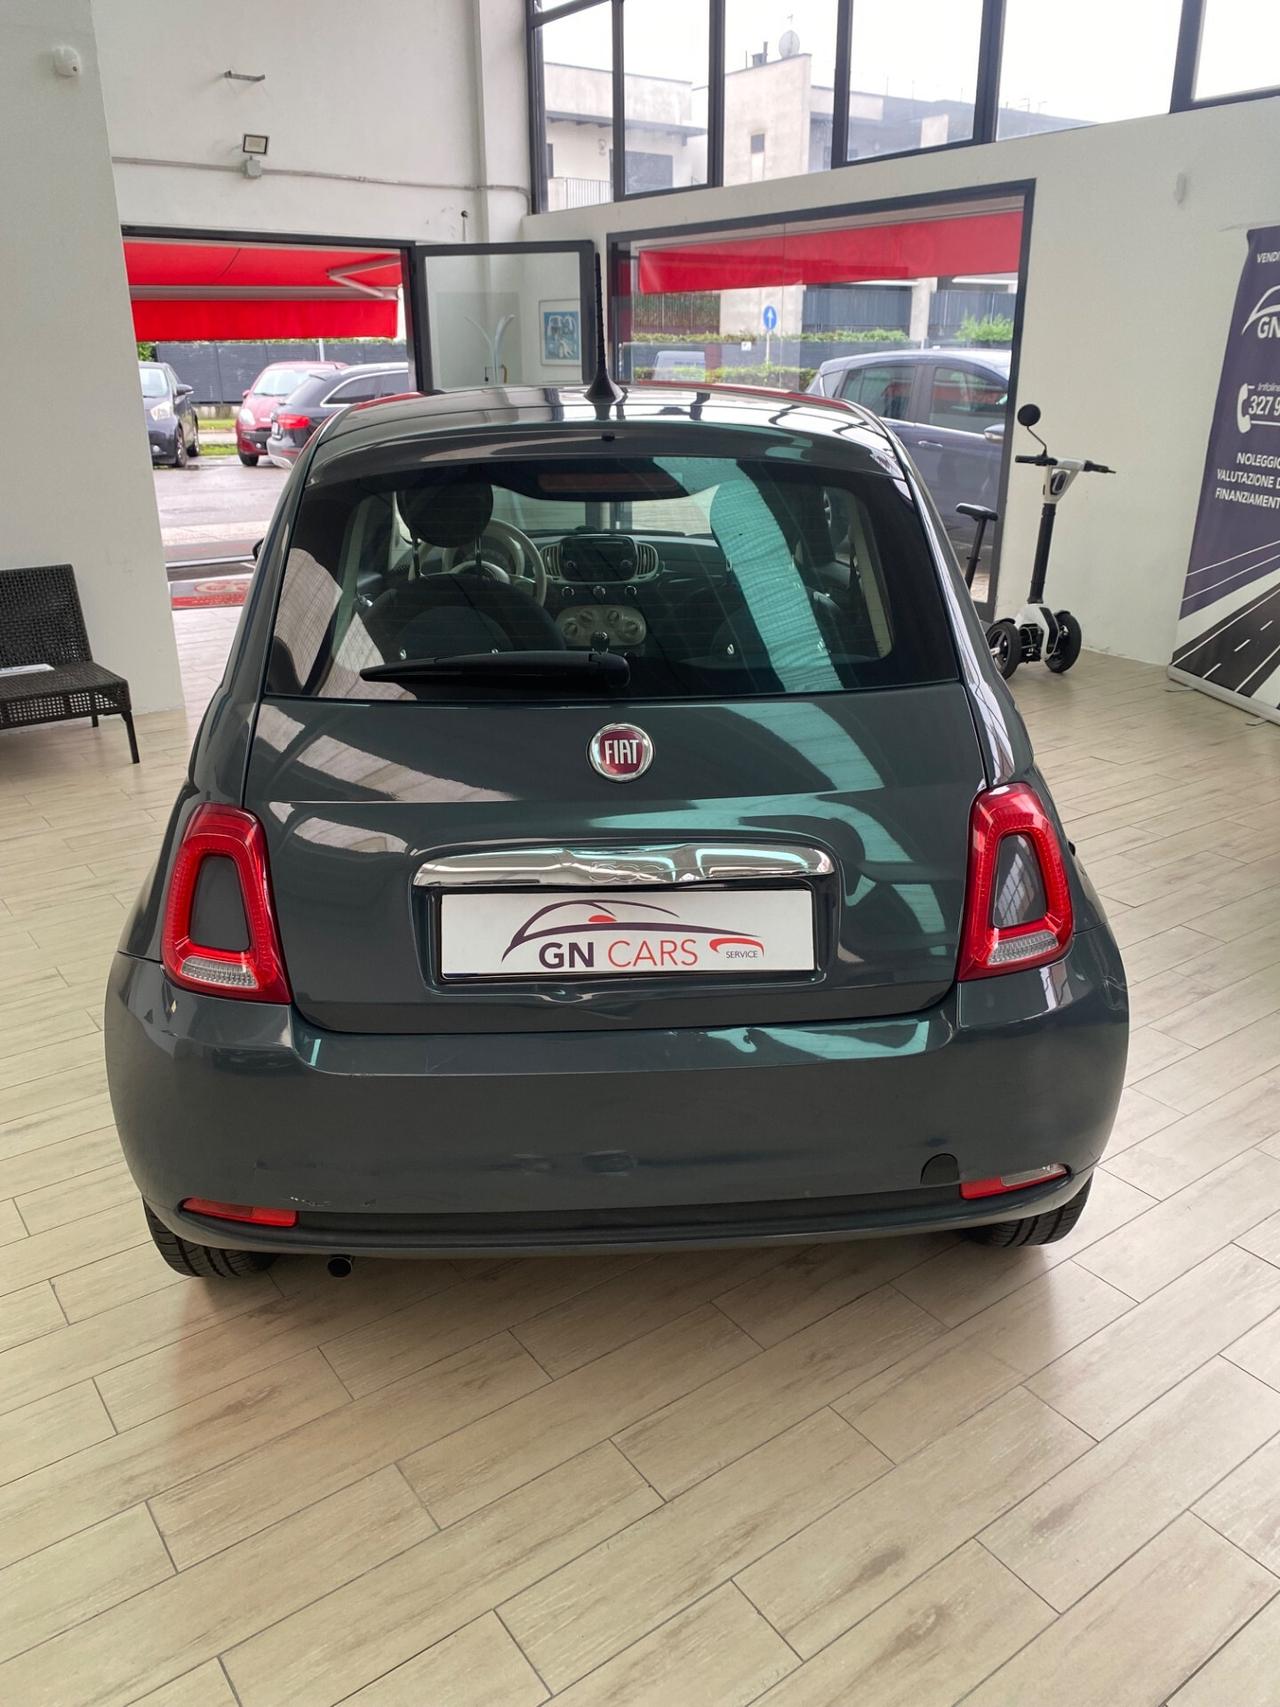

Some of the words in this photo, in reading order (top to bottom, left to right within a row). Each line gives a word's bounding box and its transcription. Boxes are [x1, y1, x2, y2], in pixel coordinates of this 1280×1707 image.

[1257, 251, 1280, 263] VEND
[1257, 316, 1280, 338] GN
[1248, 395, 1273, 415] 327
[1217, 468, 1275, 488] VALUTAZIONE
[1215, 487, 1280, 509] FINANZIAMENT
[604, 739, 639, 765] FIAT
[538, 942, 594, 969] GN
[607, 939, 698, 967] CARS
[725, 950, 759, 959] SERVICE
